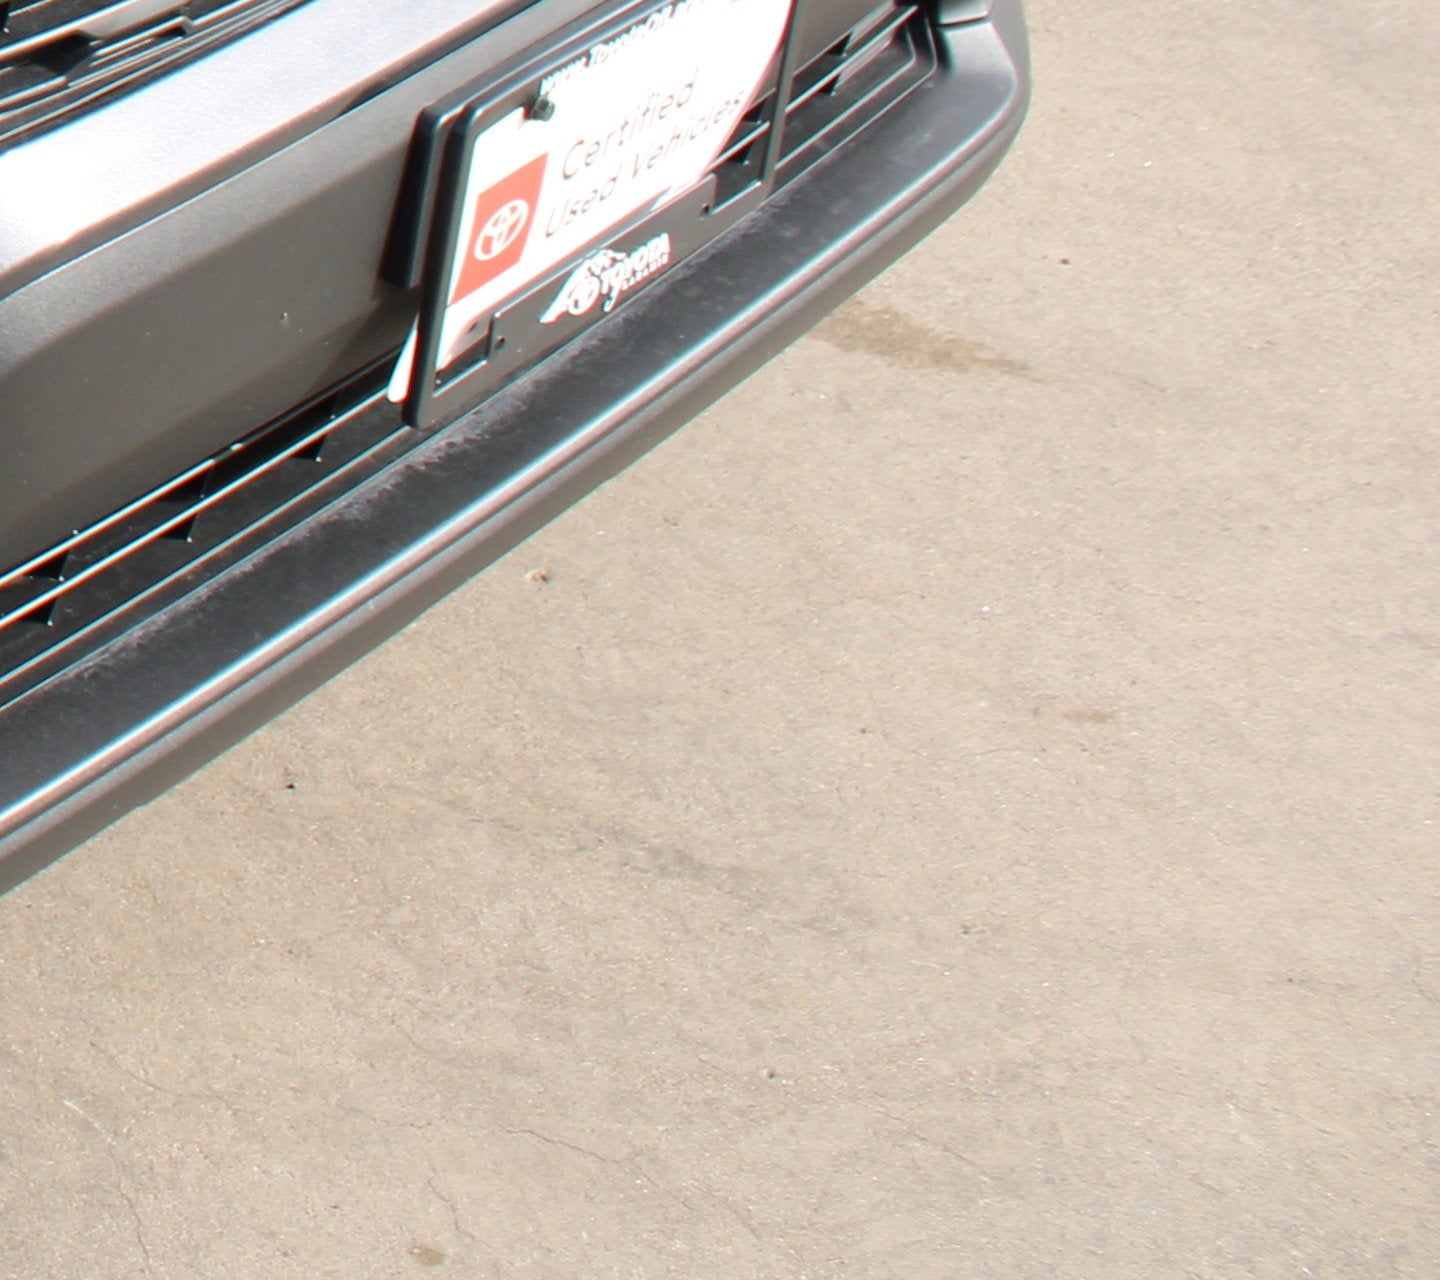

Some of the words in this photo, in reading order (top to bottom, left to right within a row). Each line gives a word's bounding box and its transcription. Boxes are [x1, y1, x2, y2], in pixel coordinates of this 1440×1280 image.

[545, 160, 624, 238] Used
[632, 90, 745, 180] Vehicles
[562, 66, 698, 181] Certified
